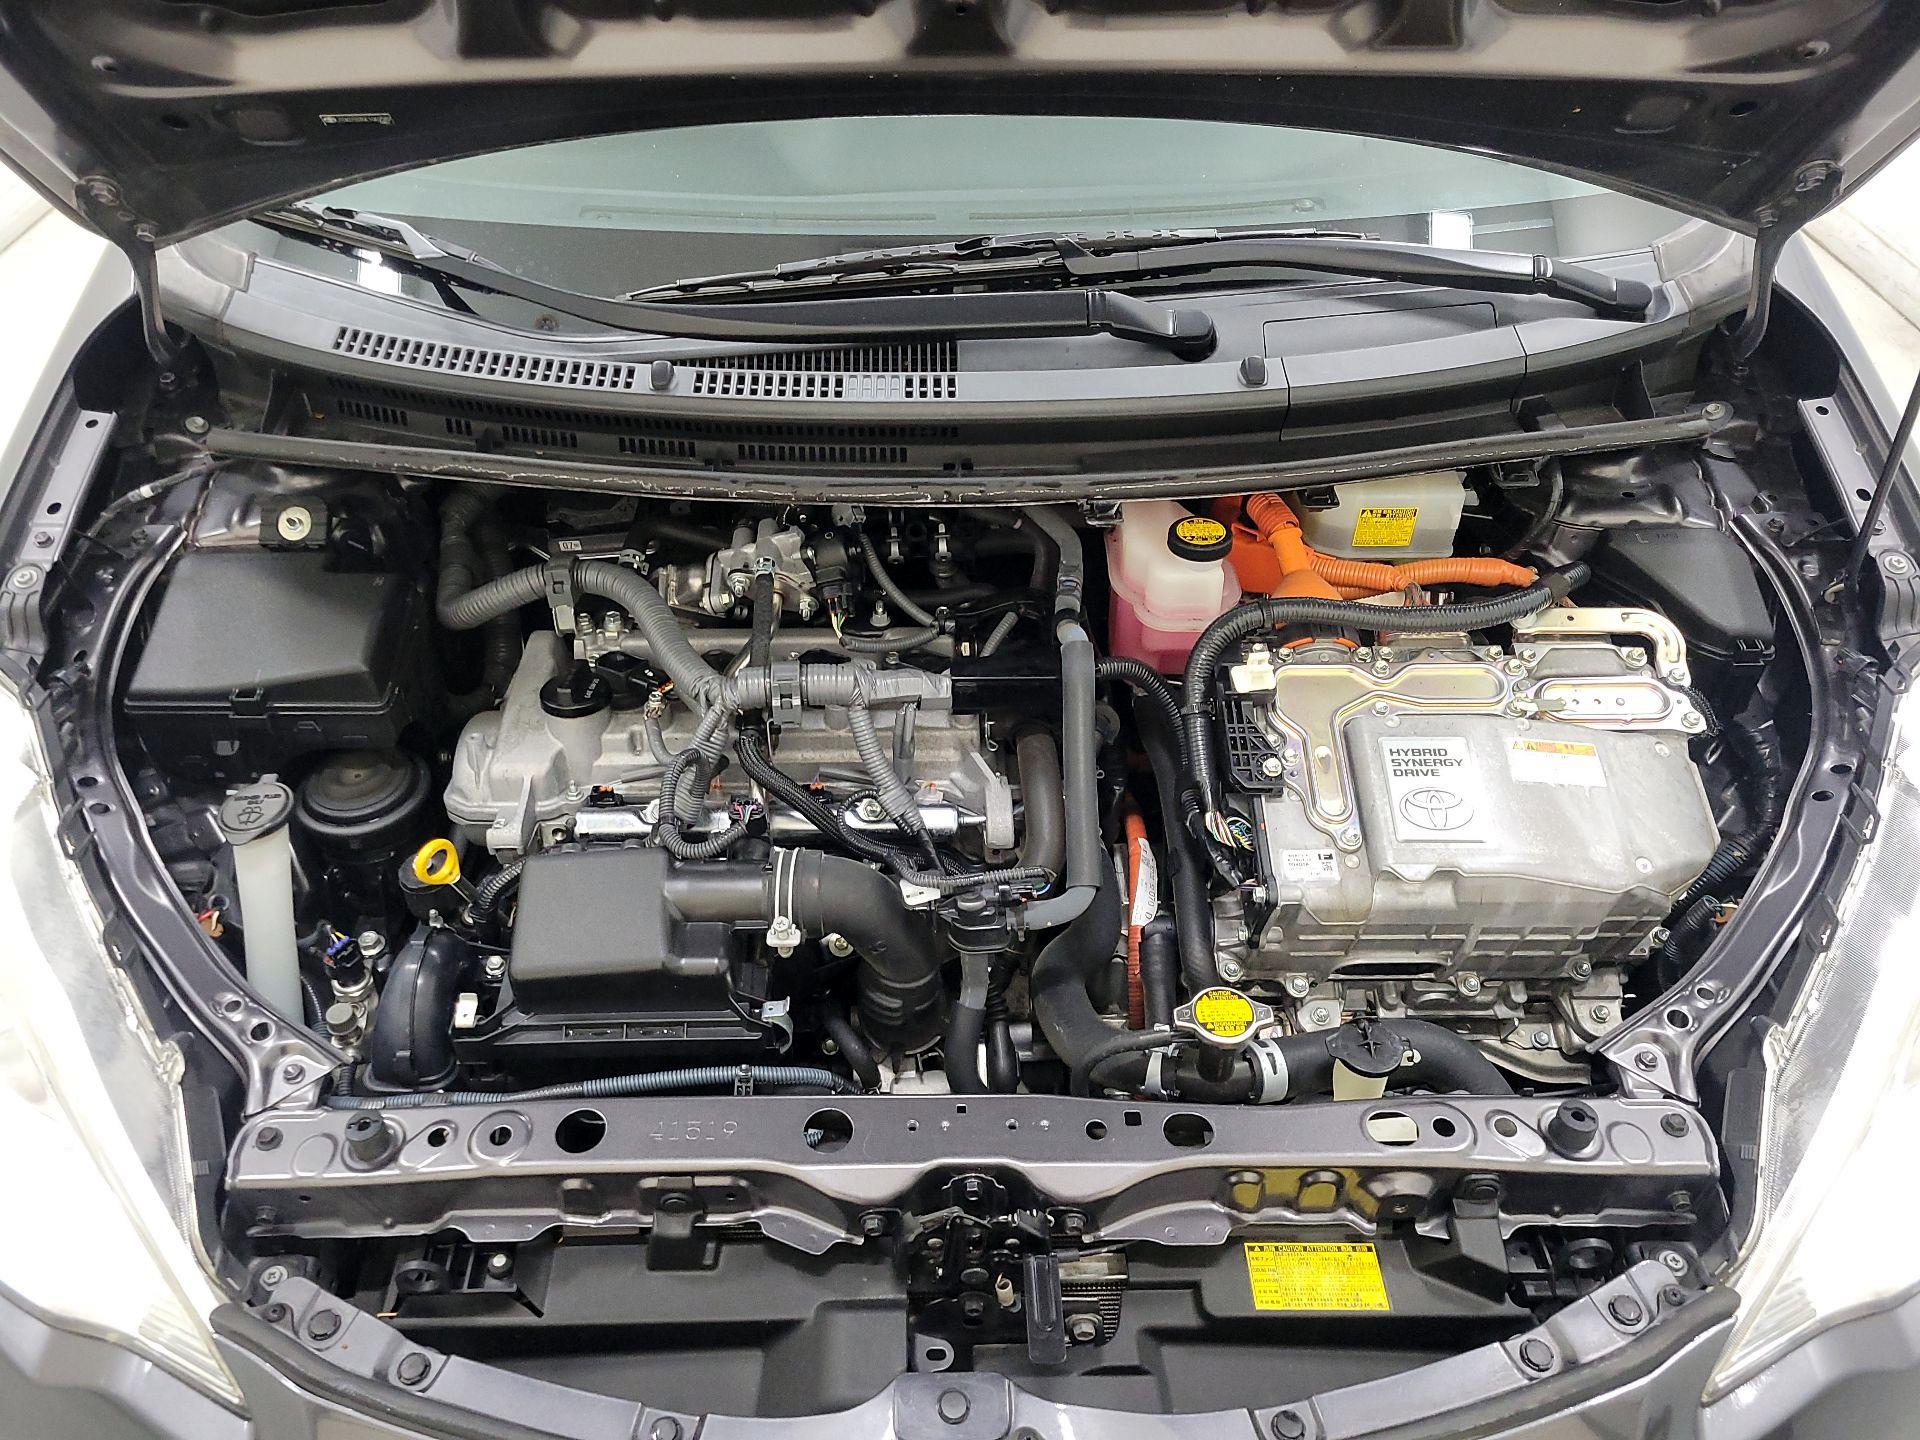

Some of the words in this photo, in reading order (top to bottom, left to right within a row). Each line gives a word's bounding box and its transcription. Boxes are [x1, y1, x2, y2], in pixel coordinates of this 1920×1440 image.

[1389, 748, 1448, 757] HYBRID
[1391, 758, 1464, 767] SYNERGY
[1393, 768, 1441, 777] DRIVE
